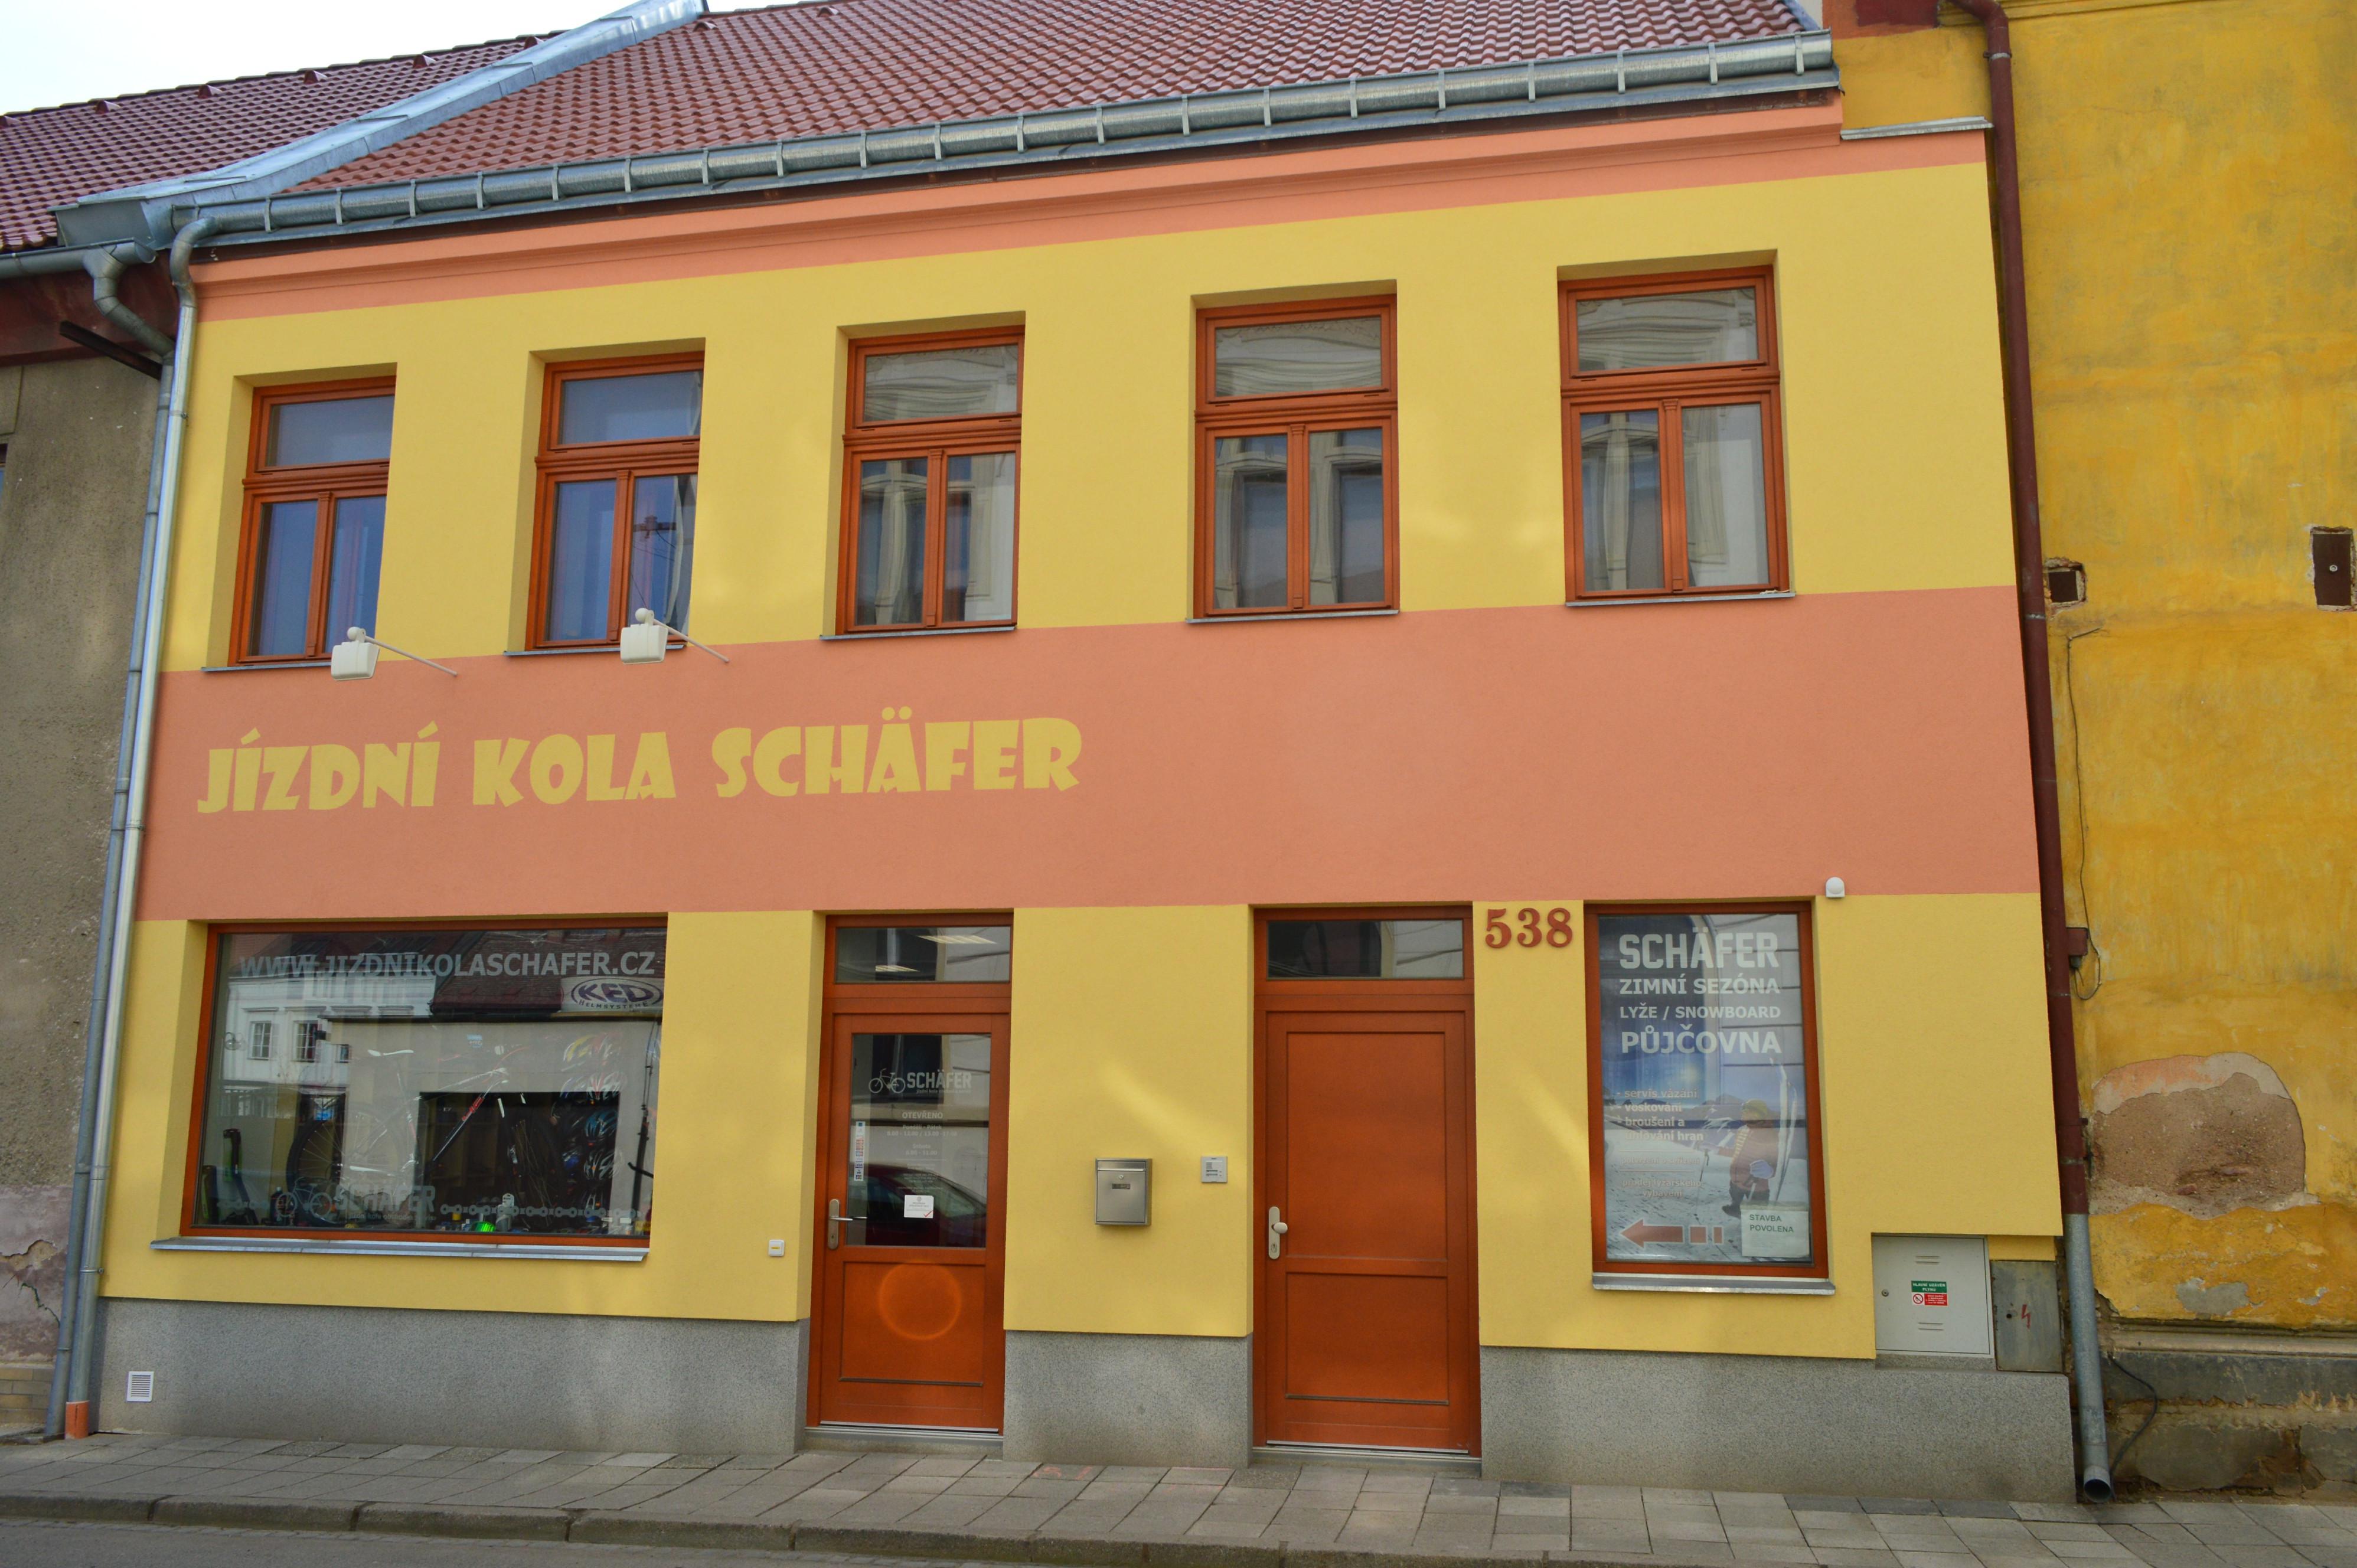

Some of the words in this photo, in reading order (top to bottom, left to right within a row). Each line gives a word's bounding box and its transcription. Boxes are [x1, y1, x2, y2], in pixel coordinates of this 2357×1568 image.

[197, 720, 441, 814] JÍZDNÍ
[473, 731, 677, 808] KOLA
[711, 705, 1082, 798] SCHÄFER
[1485, 907, 1573, 949] 538
[1619, 926, 1780, 969] SCHÄFER
[1620, 974, 1687, 995] ZIMNÍ
[1693, 973, 1780, 994] SEZÓNA
[578, 983, 654, 1003] KED
[1620, 1002, 1657, 1019] LYŽE
[1662, 1006, 1670, 1020] /
[1675, 1005, 1781, 1019] SNOWBOARD
[1621, 1023, 1783, 1054] PŮJČOVNA
[906, 1069, 972, 1089] SCHÄFER
[1624, 1089, 1658, 1099] servis
[1661, 1088, 1697, 1099] vázání
[1624, 1102, 1682, 1112] voskování
[902, 1110, 944, 1119] OTEVŘENO
[1625, 1116, 1675, 1127] broušení
[1677, 1131, 1704, 1141] hran
[1622, 1178, 1652, 1188] prodej
[1749, 1214, 1782, 1222] STAVBA
[1749, 1224, 1794, 1233] POVOLENA
